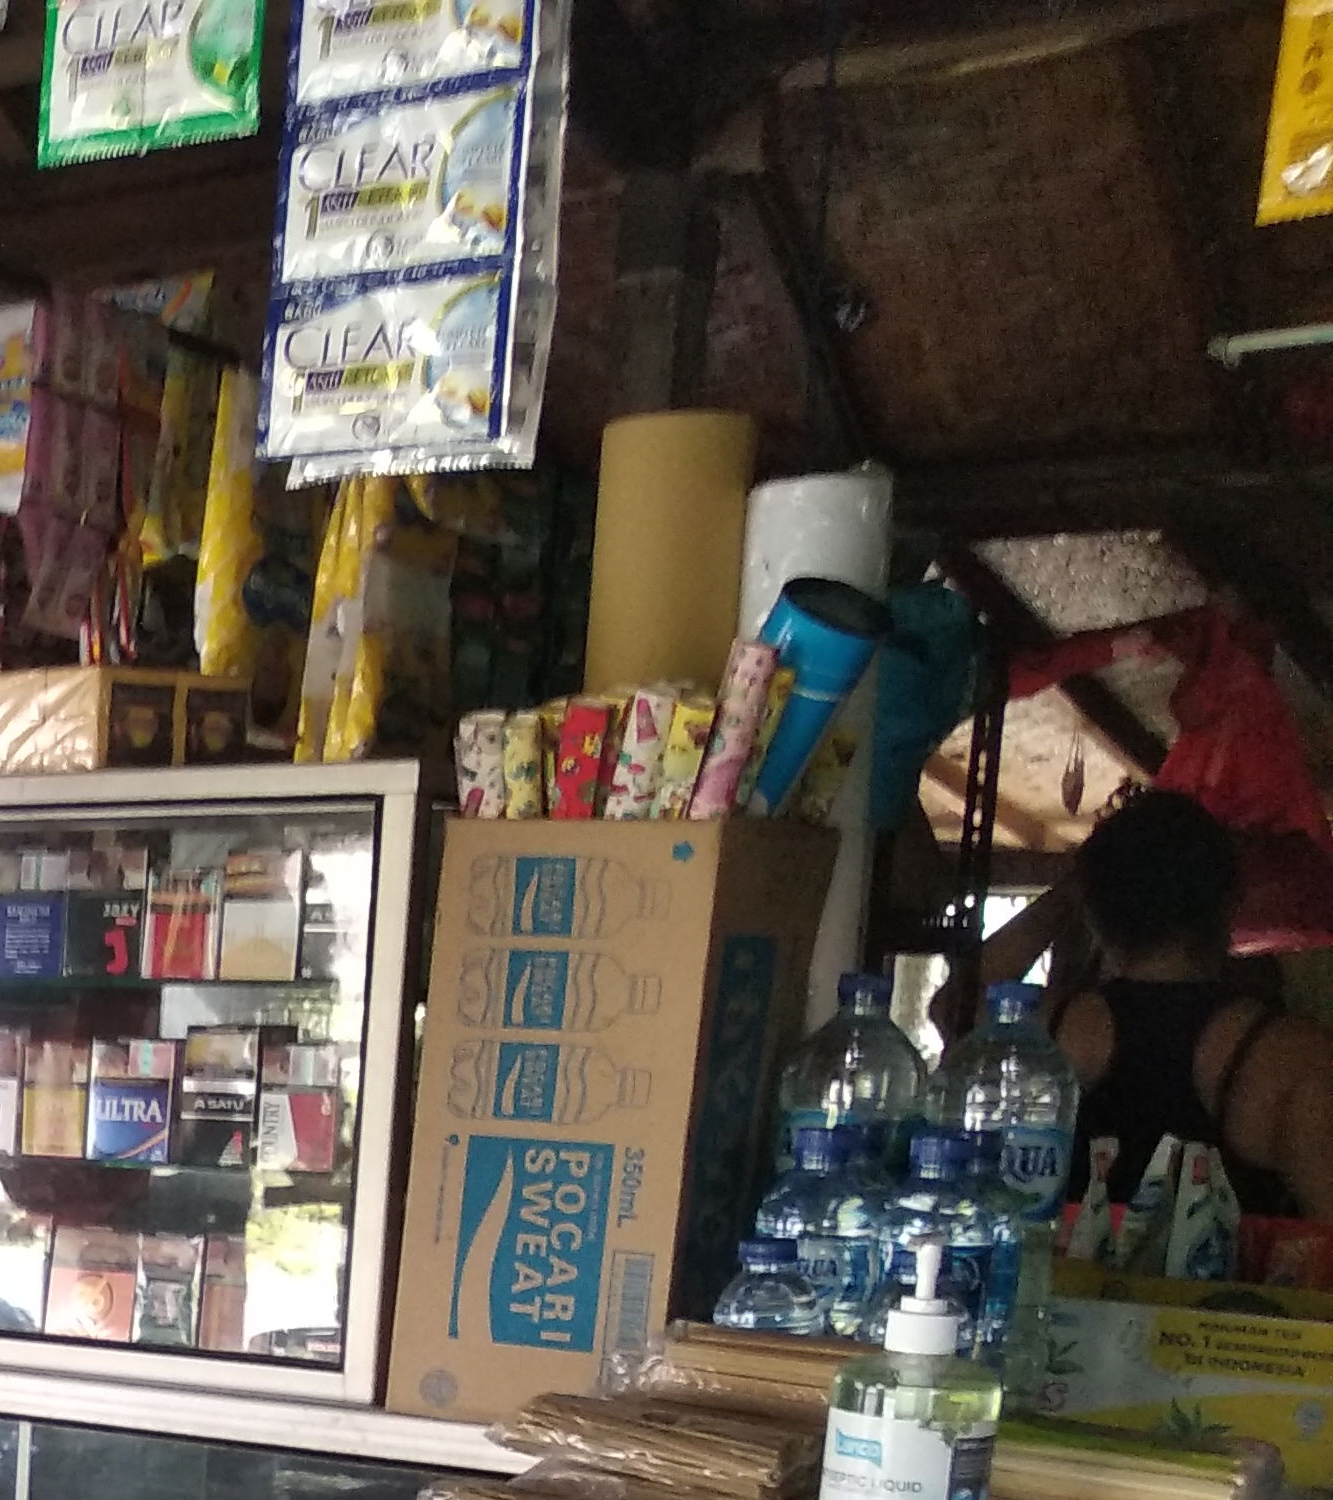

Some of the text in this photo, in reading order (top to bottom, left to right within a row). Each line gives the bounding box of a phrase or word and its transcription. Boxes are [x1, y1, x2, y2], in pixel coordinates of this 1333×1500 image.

[63, 0, 183, 53] CLEAR
[299, 143, 435, 192] CLEAR
[284, 321, 417, 370] CLEAR
[96, 1098, 163, 1123] ULTRA
[618, 1147, 644, 1228] 350mL
[510, 1149, 556, 1323] SWEAT
[541, 1151, 590, 1342] POCARI
